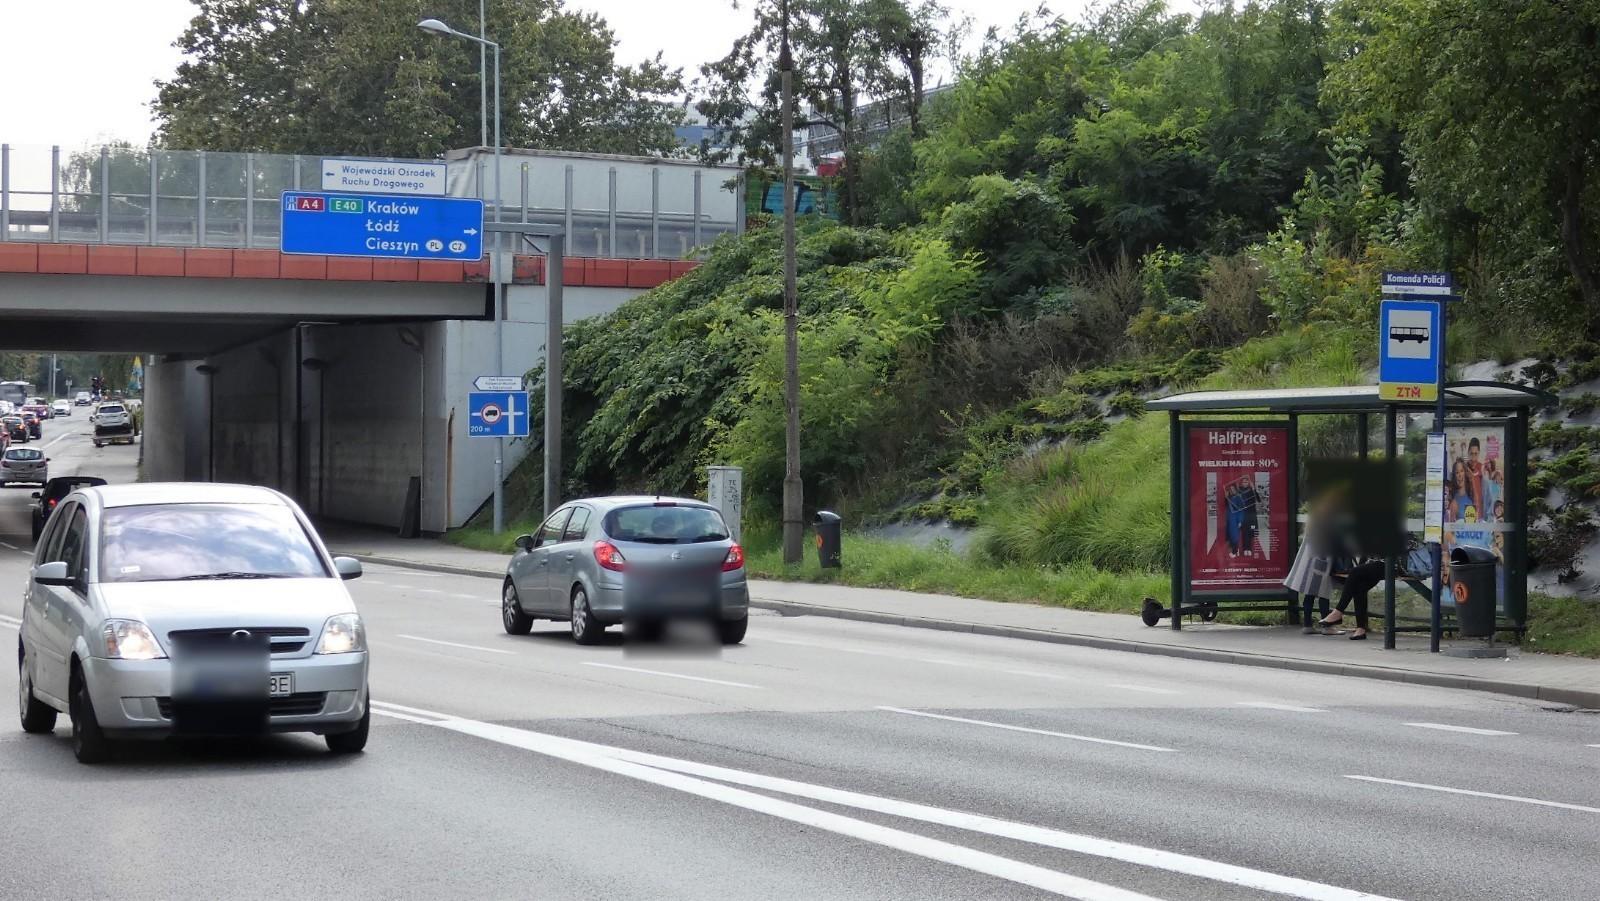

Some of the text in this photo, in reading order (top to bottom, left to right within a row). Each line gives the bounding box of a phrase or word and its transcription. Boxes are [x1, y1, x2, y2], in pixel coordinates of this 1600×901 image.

[342, 177, 424, 190] Ruchu Drogowego
[367, 200, 420, 215] Kraków
[365, 218, 400, 233] Łódź
[366, 237, 419, 255] Cieszyn
[430, 241, 439, 250] PL
[1387, 273, 1446, 286] Komenda Policji
[470, 425, 483, 433] 200
[1208, 431, 1267, 445] HalfPrice
